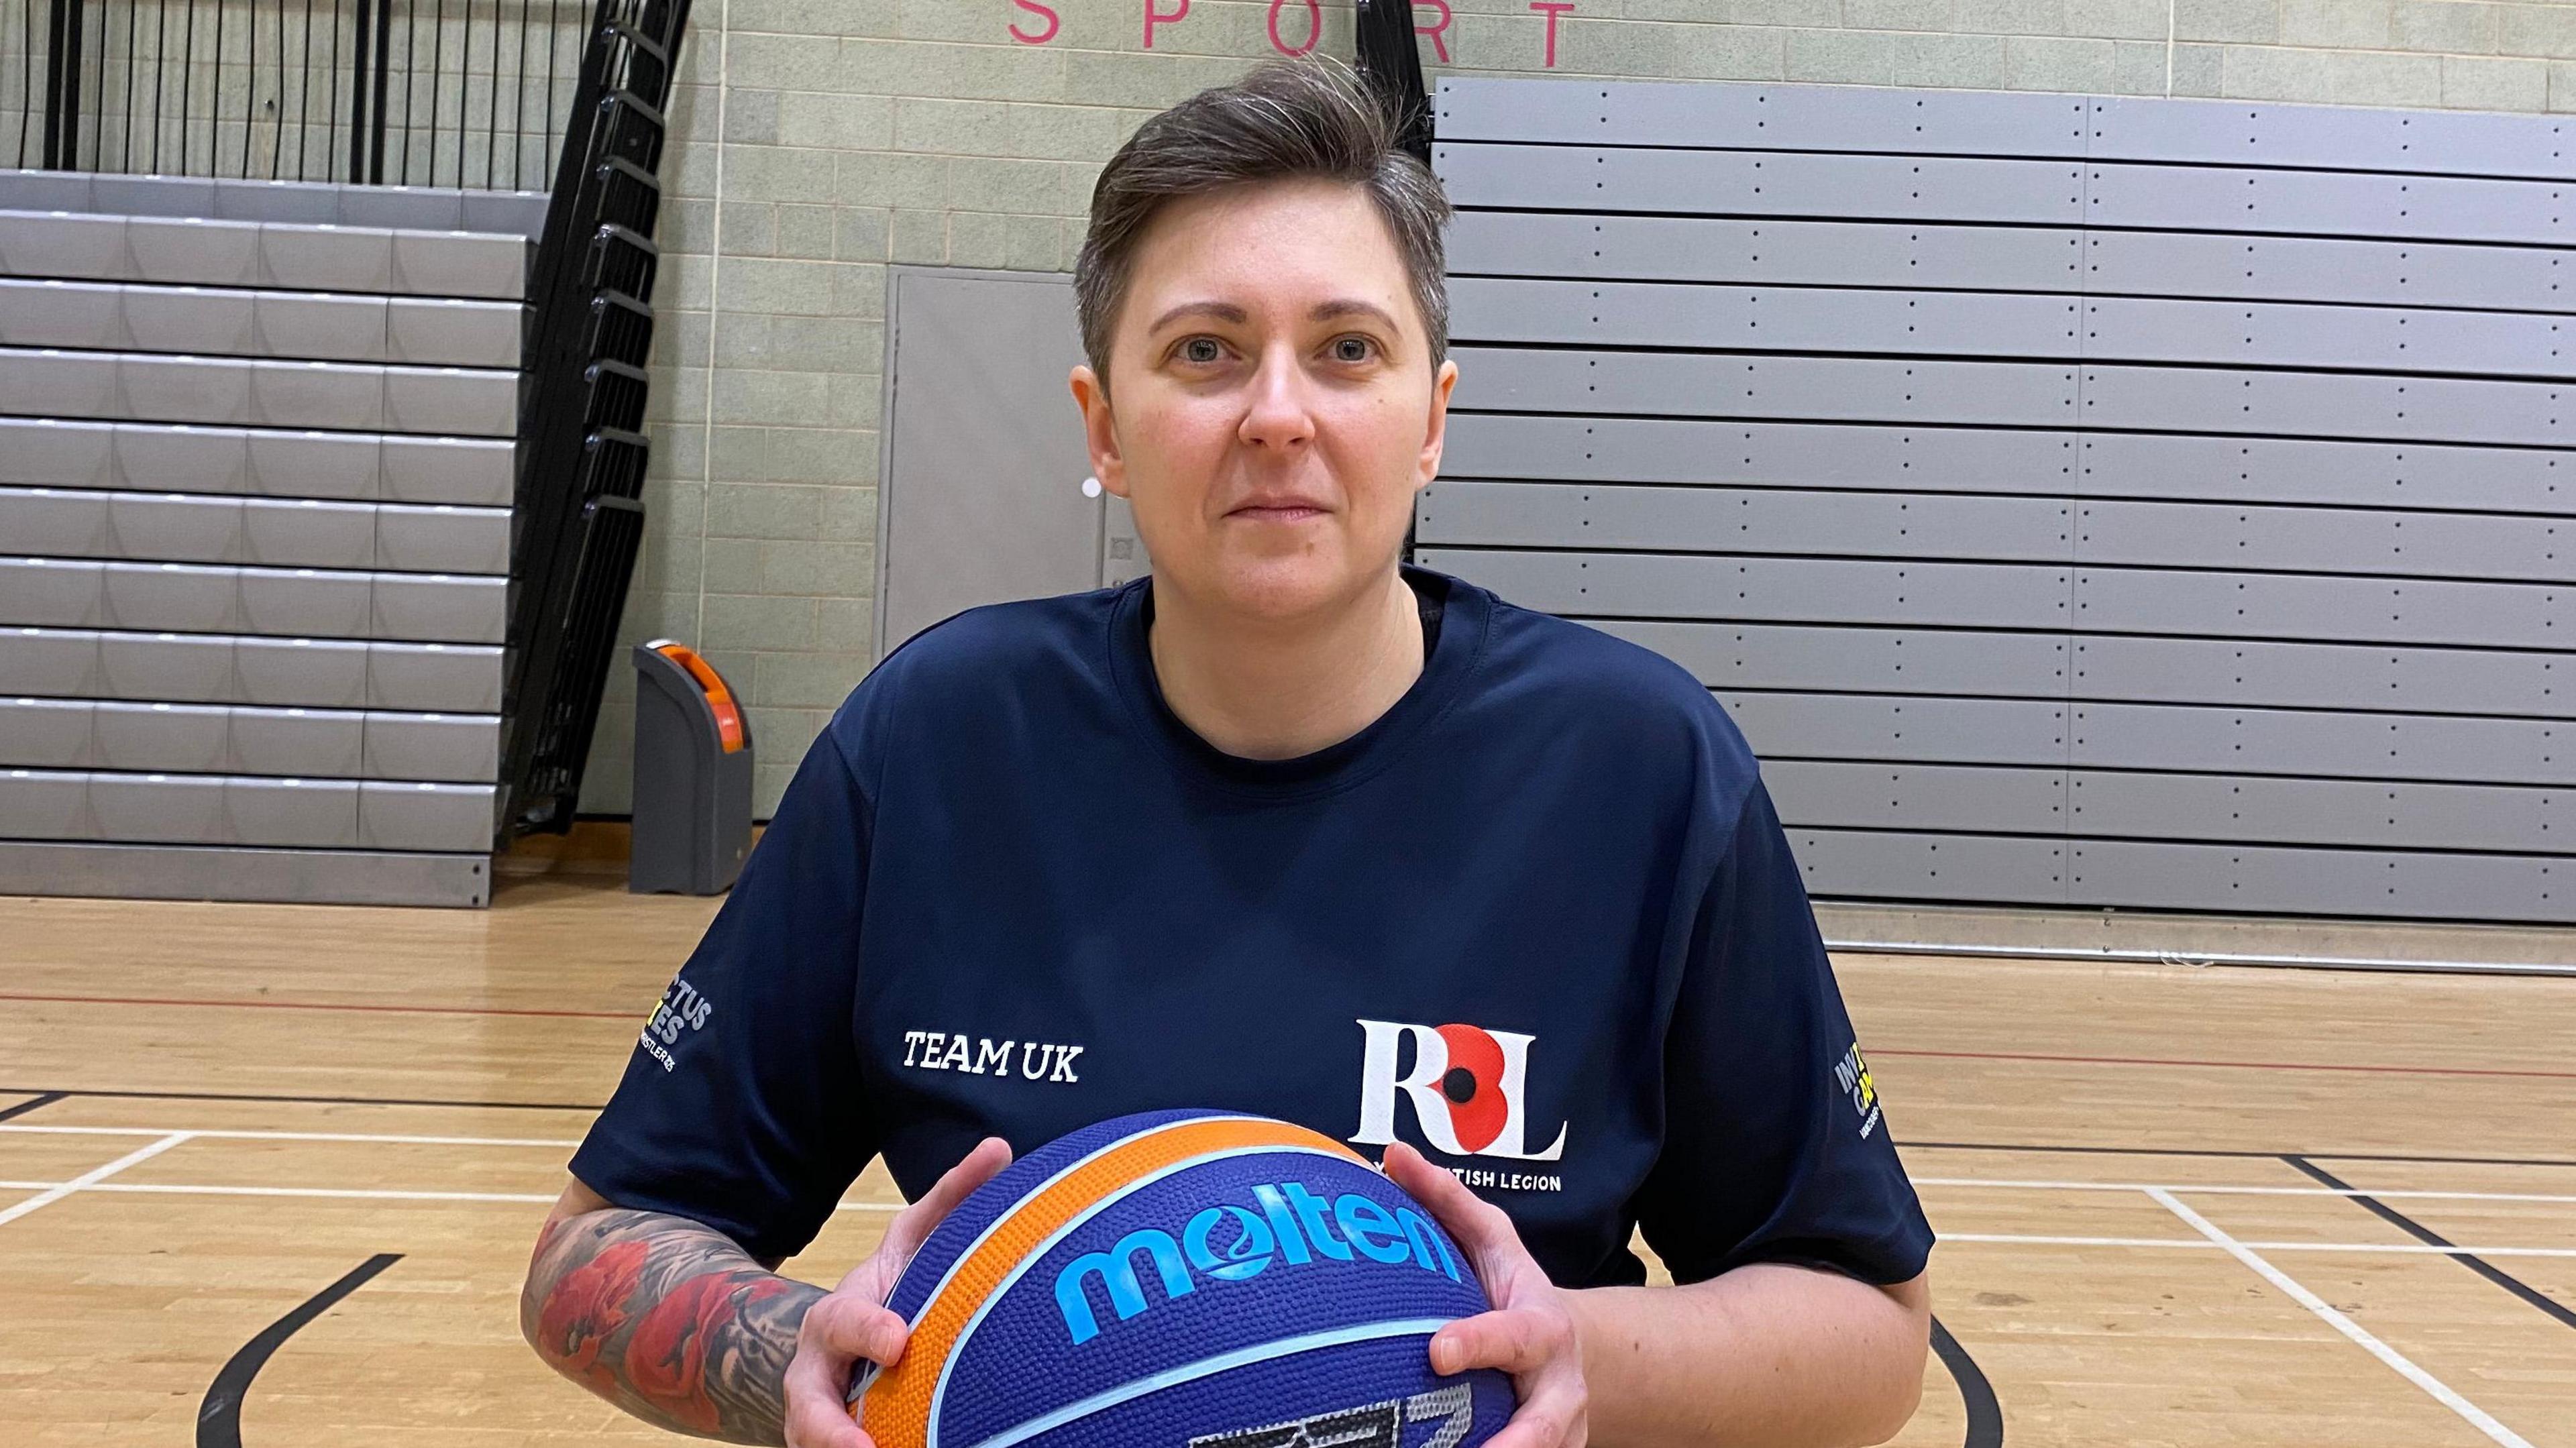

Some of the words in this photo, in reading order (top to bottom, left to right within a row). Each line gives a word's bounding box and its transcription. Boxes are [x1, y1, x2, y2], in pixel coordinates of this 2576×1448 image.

[1008, 0, 1574, 68] SPORT
[904, 1032, 1014, 1076] TEAM
[1023, 1042, 1084, 1082] UK
[1445, 1168, 1495, 1187] TISH
[1501, 1173, 1561, 1191] LEGION
[1055, 1181, 1461, 1345] molten
